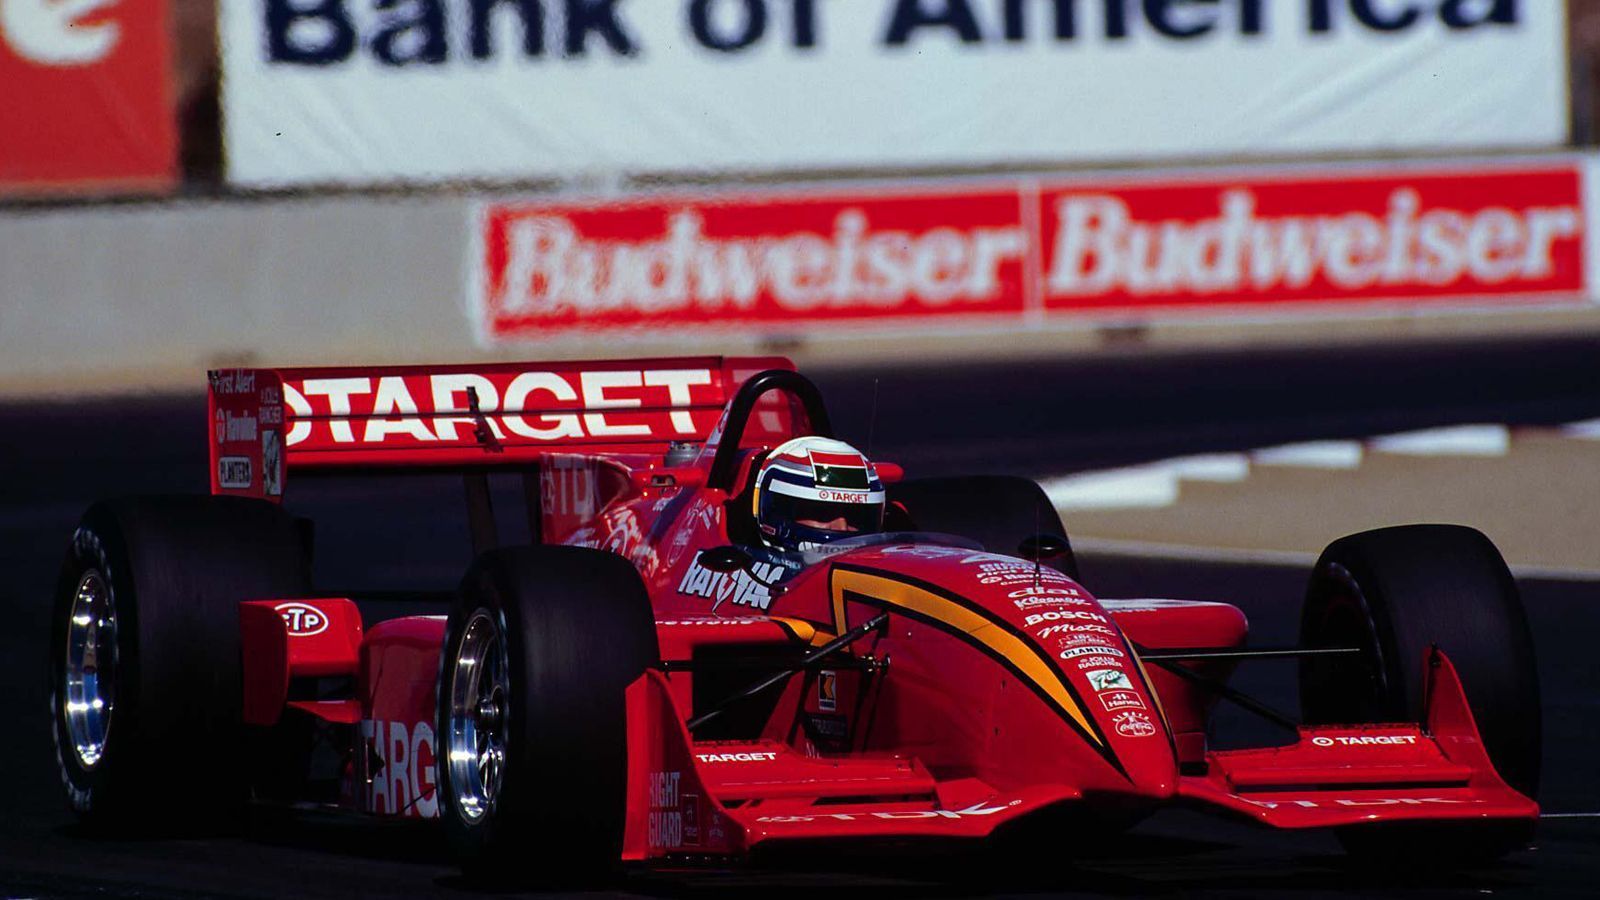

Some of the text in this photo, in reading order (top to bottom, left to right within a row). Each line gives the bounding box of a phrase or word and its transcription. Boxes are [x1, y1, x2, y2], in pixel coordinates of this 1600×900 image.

[1048, 188, 1578, 295] Budweiser
[500, 212, 1025, 315] Budweiser
[303, 369, 712, 443] TARGET
[830, 491, 869, 504] TARGET
[1008, 586, 1079, 598] dial
[1024, 610, 1108, 627] BOSCH
[1063, 647, 1122, 658] PLANTERS
[1108, 700, 1141, 708] Hanes
[1334, 735, 1417, 746] TARGET
[695, 752, 777, 763] TARGET
[649, 771, 680, 807] RIGHT
[648, 811, 681, 848] GUARD
